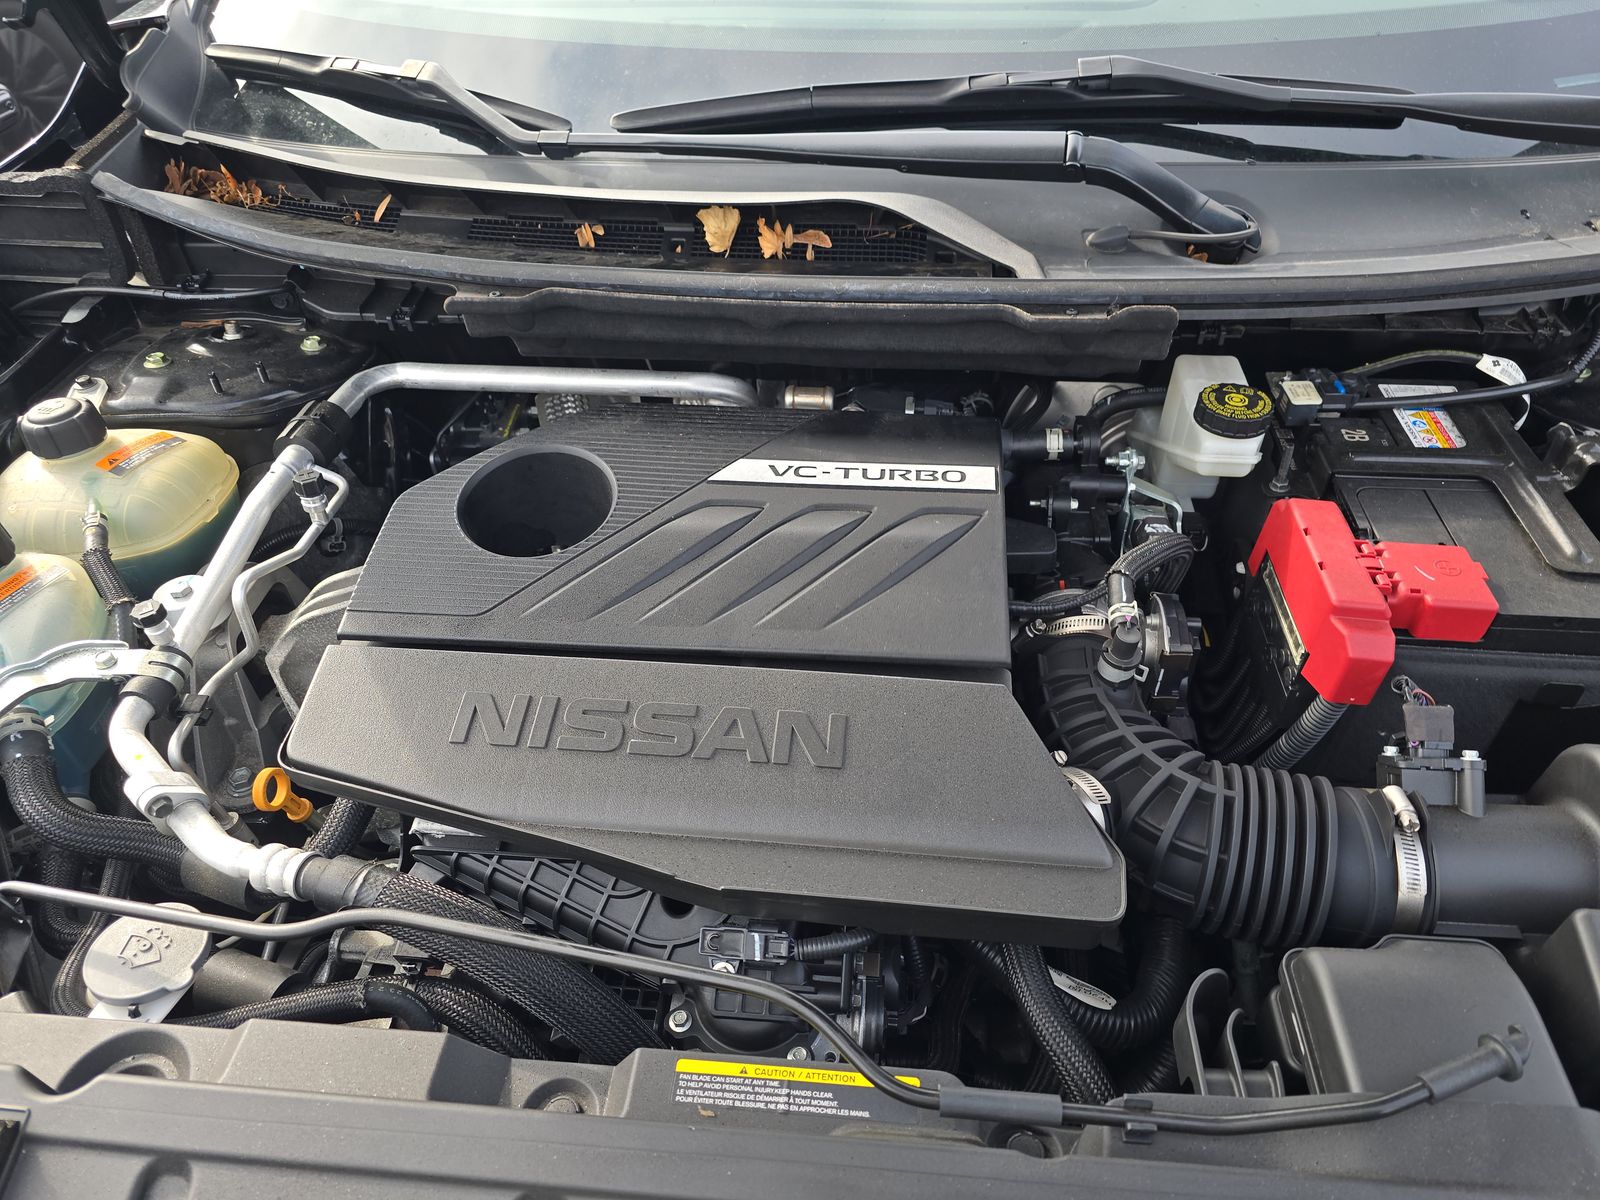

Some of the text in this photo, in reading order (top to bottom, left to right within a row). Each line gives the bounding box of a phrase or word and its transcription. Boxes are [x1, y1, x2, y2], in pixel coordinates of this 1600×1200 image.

[768, 464, 967, 483] VC-TURBO
[449, 691, 848, 769] NISSAN
[692, 1074, 711, 1082] BLADE
[752, 1078, 764, 1086] ANY
[754, 1067, 795, 1079] CAUTION
[805, 1072, 856, 1083] ATTENTION
[704, 1082, 721, 1090] AVOID
[722, 1084, 753, 1092] PERSONAL
[685, 1089, 723, 1098] VENTILATEUR
[723, 1092, 745, 1100] RISQUE
[756, 1093, 789, 1103] DÉMARRER
[694, 1095, 714, 1104] ÉVITER
[715, 1098, 734, 1106] TOUTE
[799, 1105, 837, 1115] APPROCHER
[837, 1108, 849, 1116] LES
